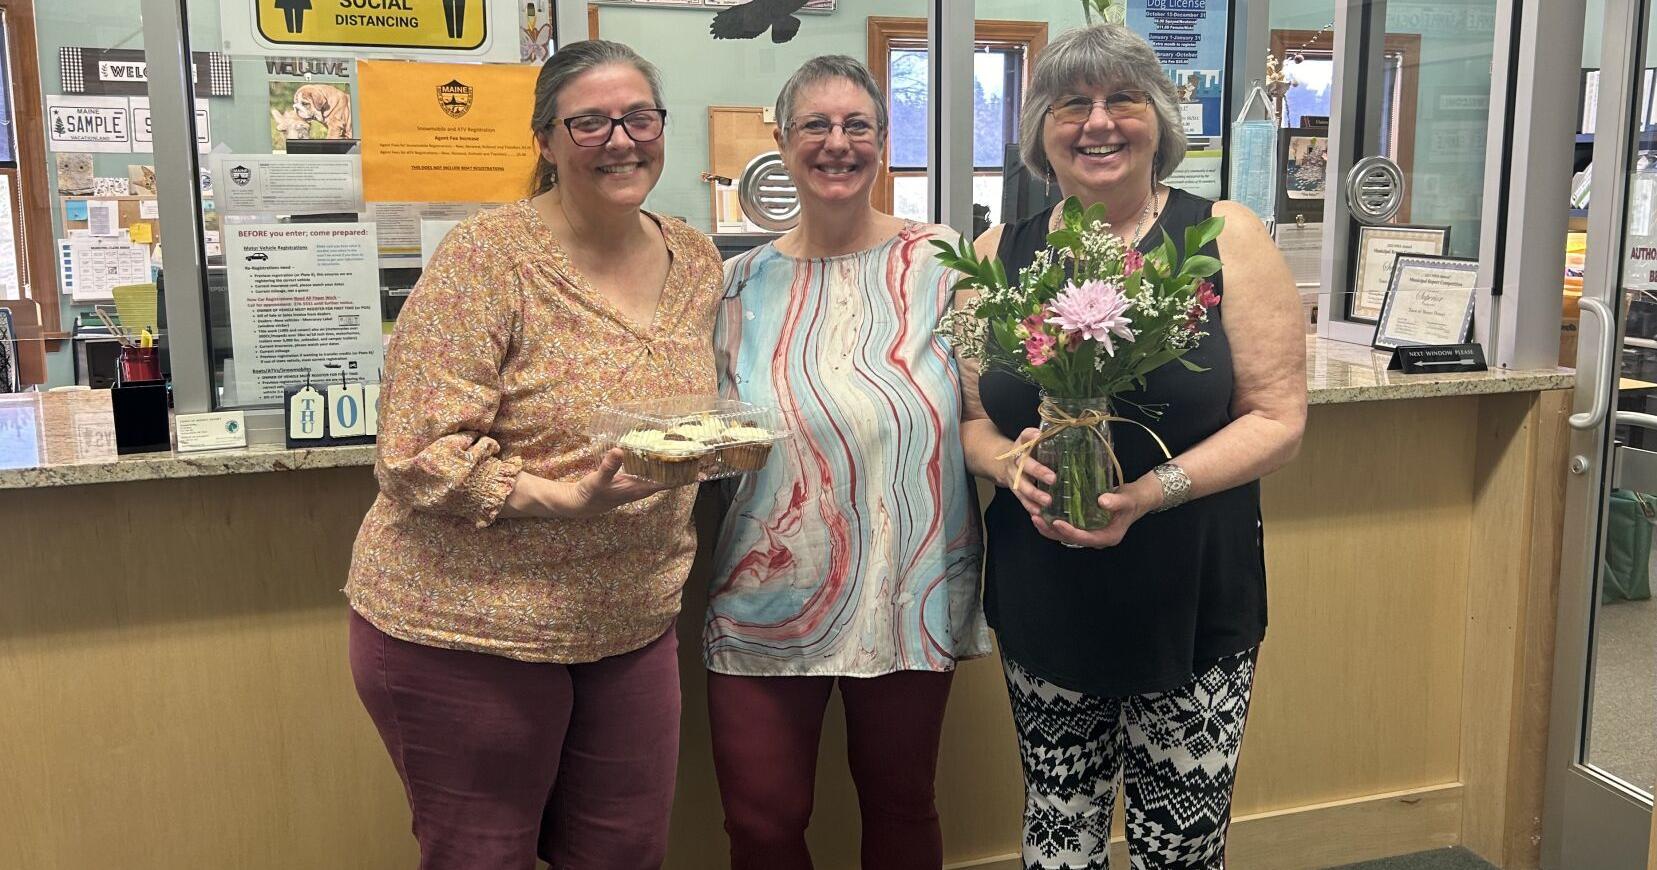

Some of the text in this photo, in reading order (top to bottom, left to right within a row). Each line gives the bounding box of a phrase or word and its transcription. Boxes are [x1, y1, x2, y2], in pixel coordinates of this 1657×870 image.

[1148, 0, 1205, 10] Dog License
[336, 14, 418, 28] DISTANCING
[67, 116, 122, 133] SAMPLE
[332, 230, 368, 238] prepared:
